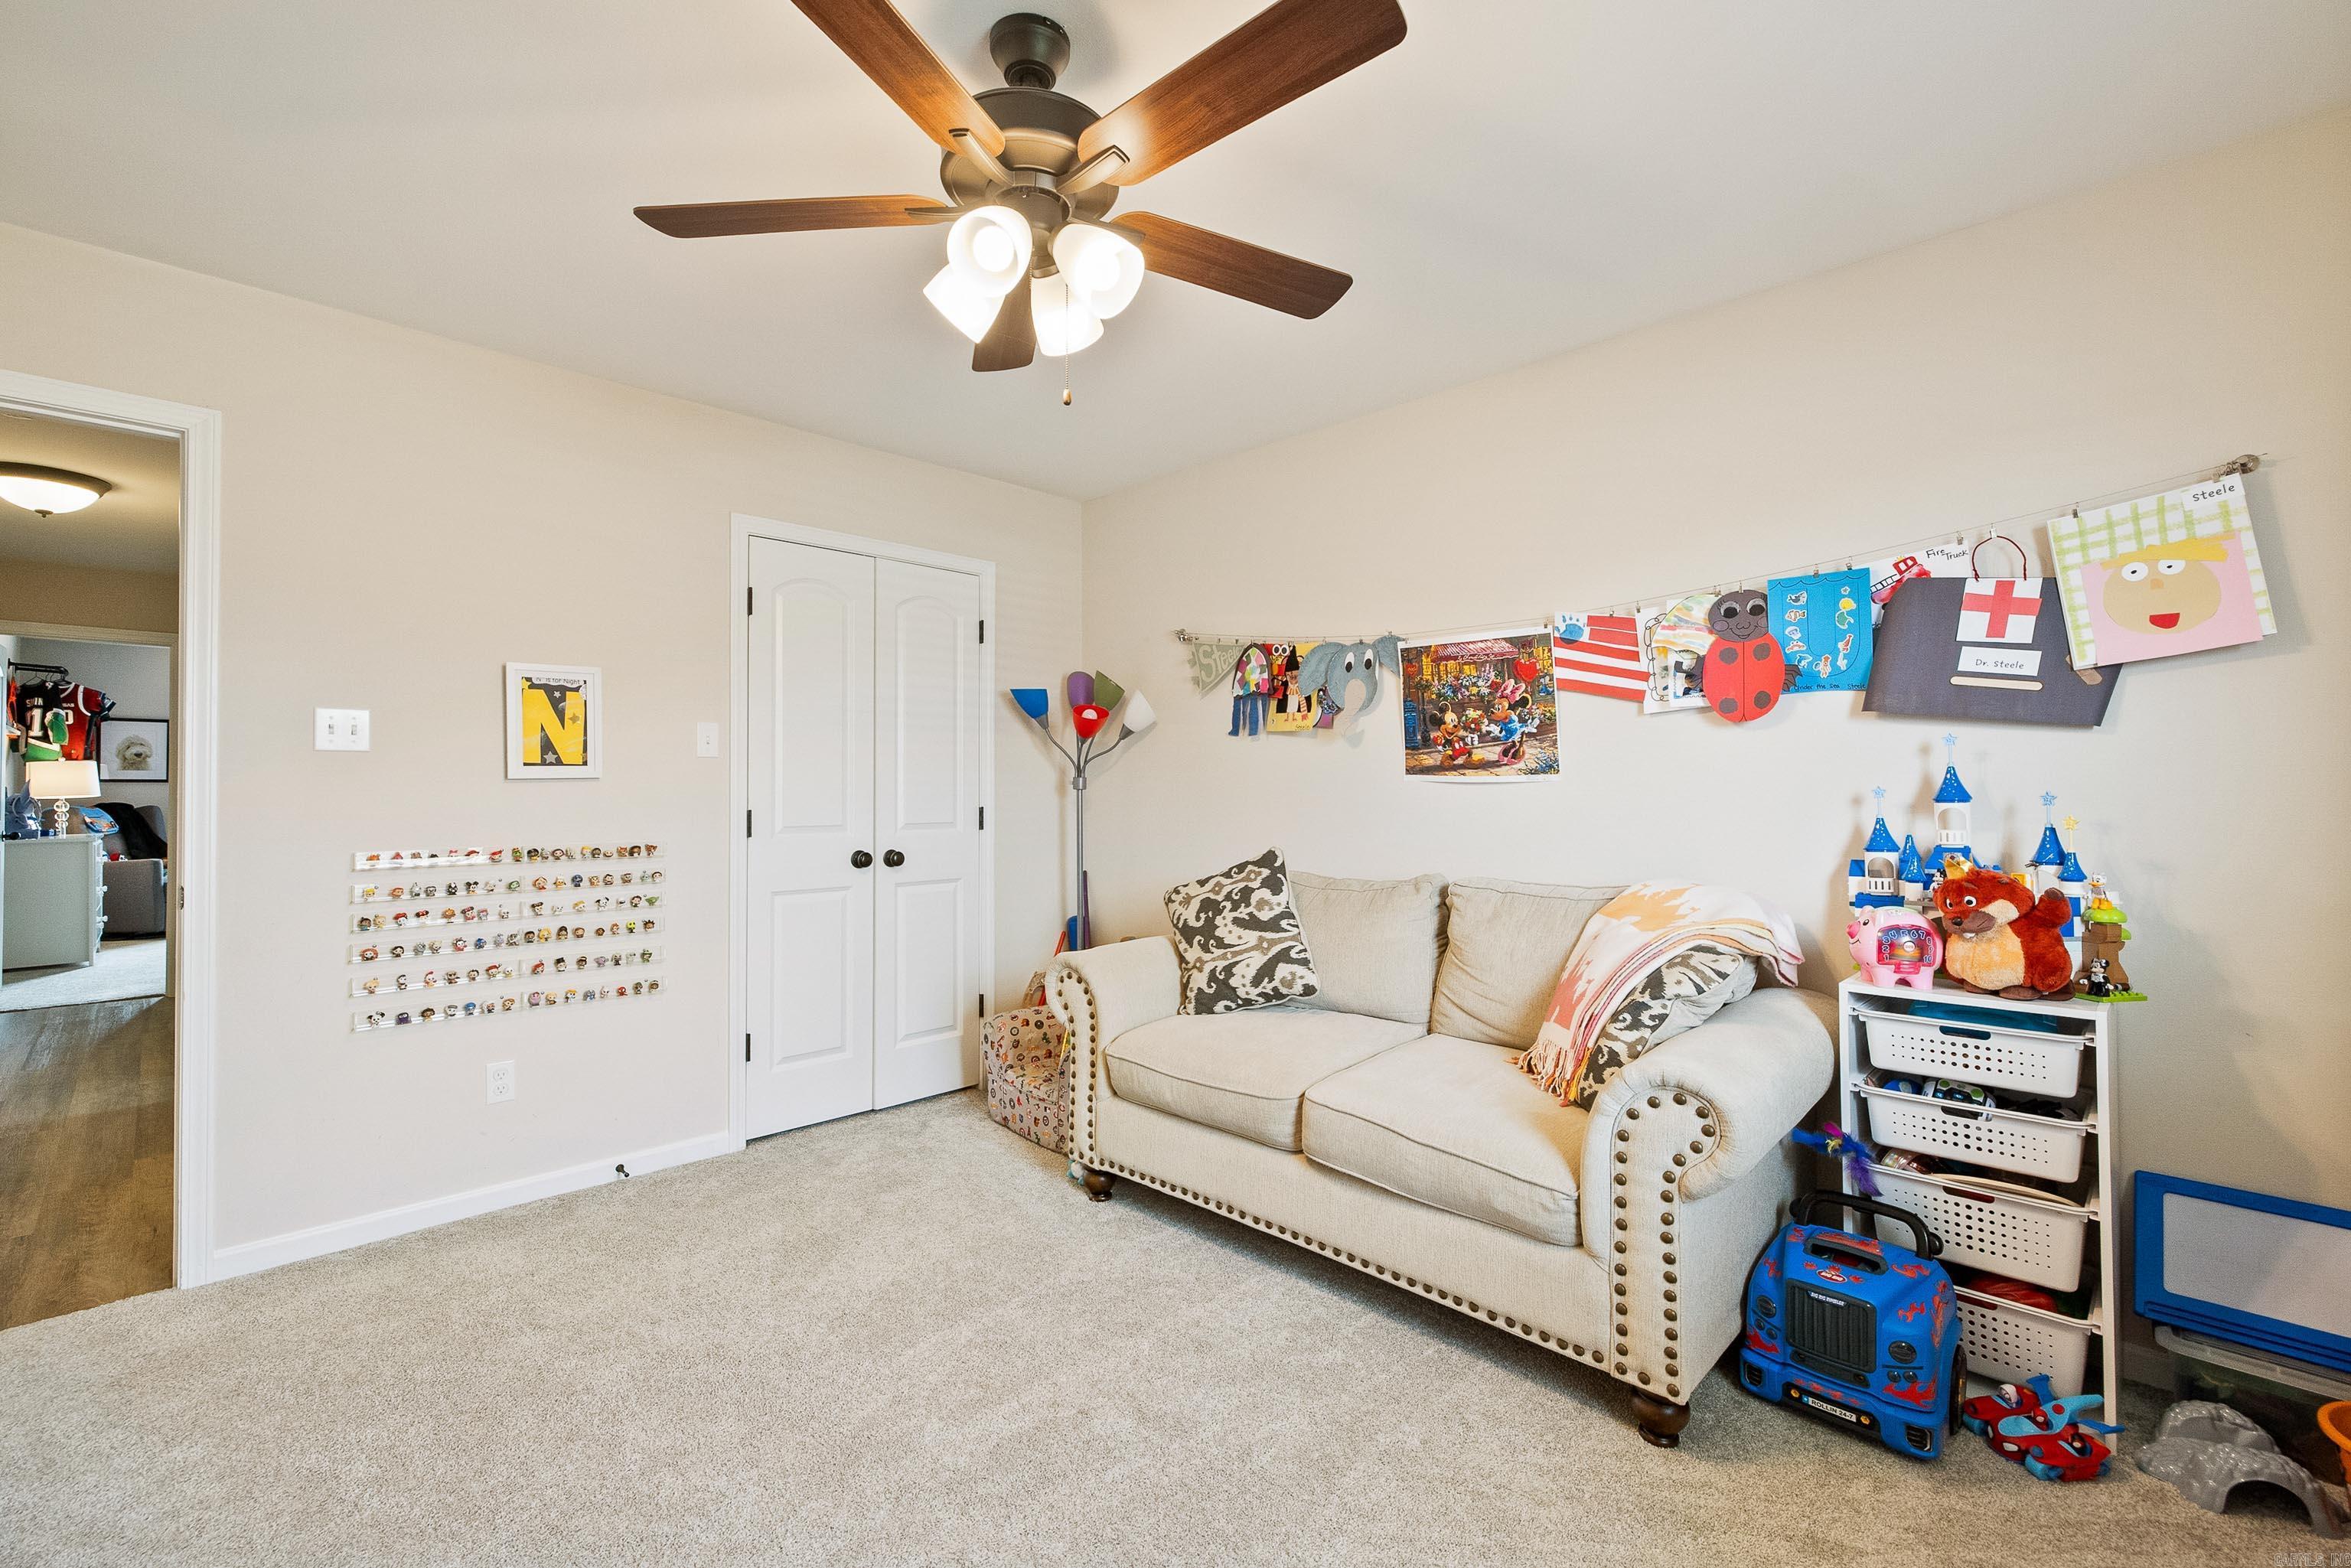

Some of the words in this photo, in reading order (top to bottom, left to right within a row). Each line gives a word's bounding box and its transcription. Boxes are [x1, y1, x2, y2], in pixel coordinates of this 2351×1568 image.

[1926, 549, 1945, 559] Fire
[1942, 550, 1968, 560] Truck
[1975, 658, 1989, 667] Dr.
[1994, 660, 2025, 670] Steele
[523, 689, 585, 764] N
[1889, 930, 1897, 939] 4
[1910, 930, 1918, 938] 6
[1919, 931, 1925, 939] 7
[1883, 936, 1890, 944] 3
[1926, 937, 1932, 945] 8
[1923, 955, 1933, 963] 10
[1811, 1399, 1837, 1414] ROLLIN
[1838, 1410, 1854, 1420] 24-7
